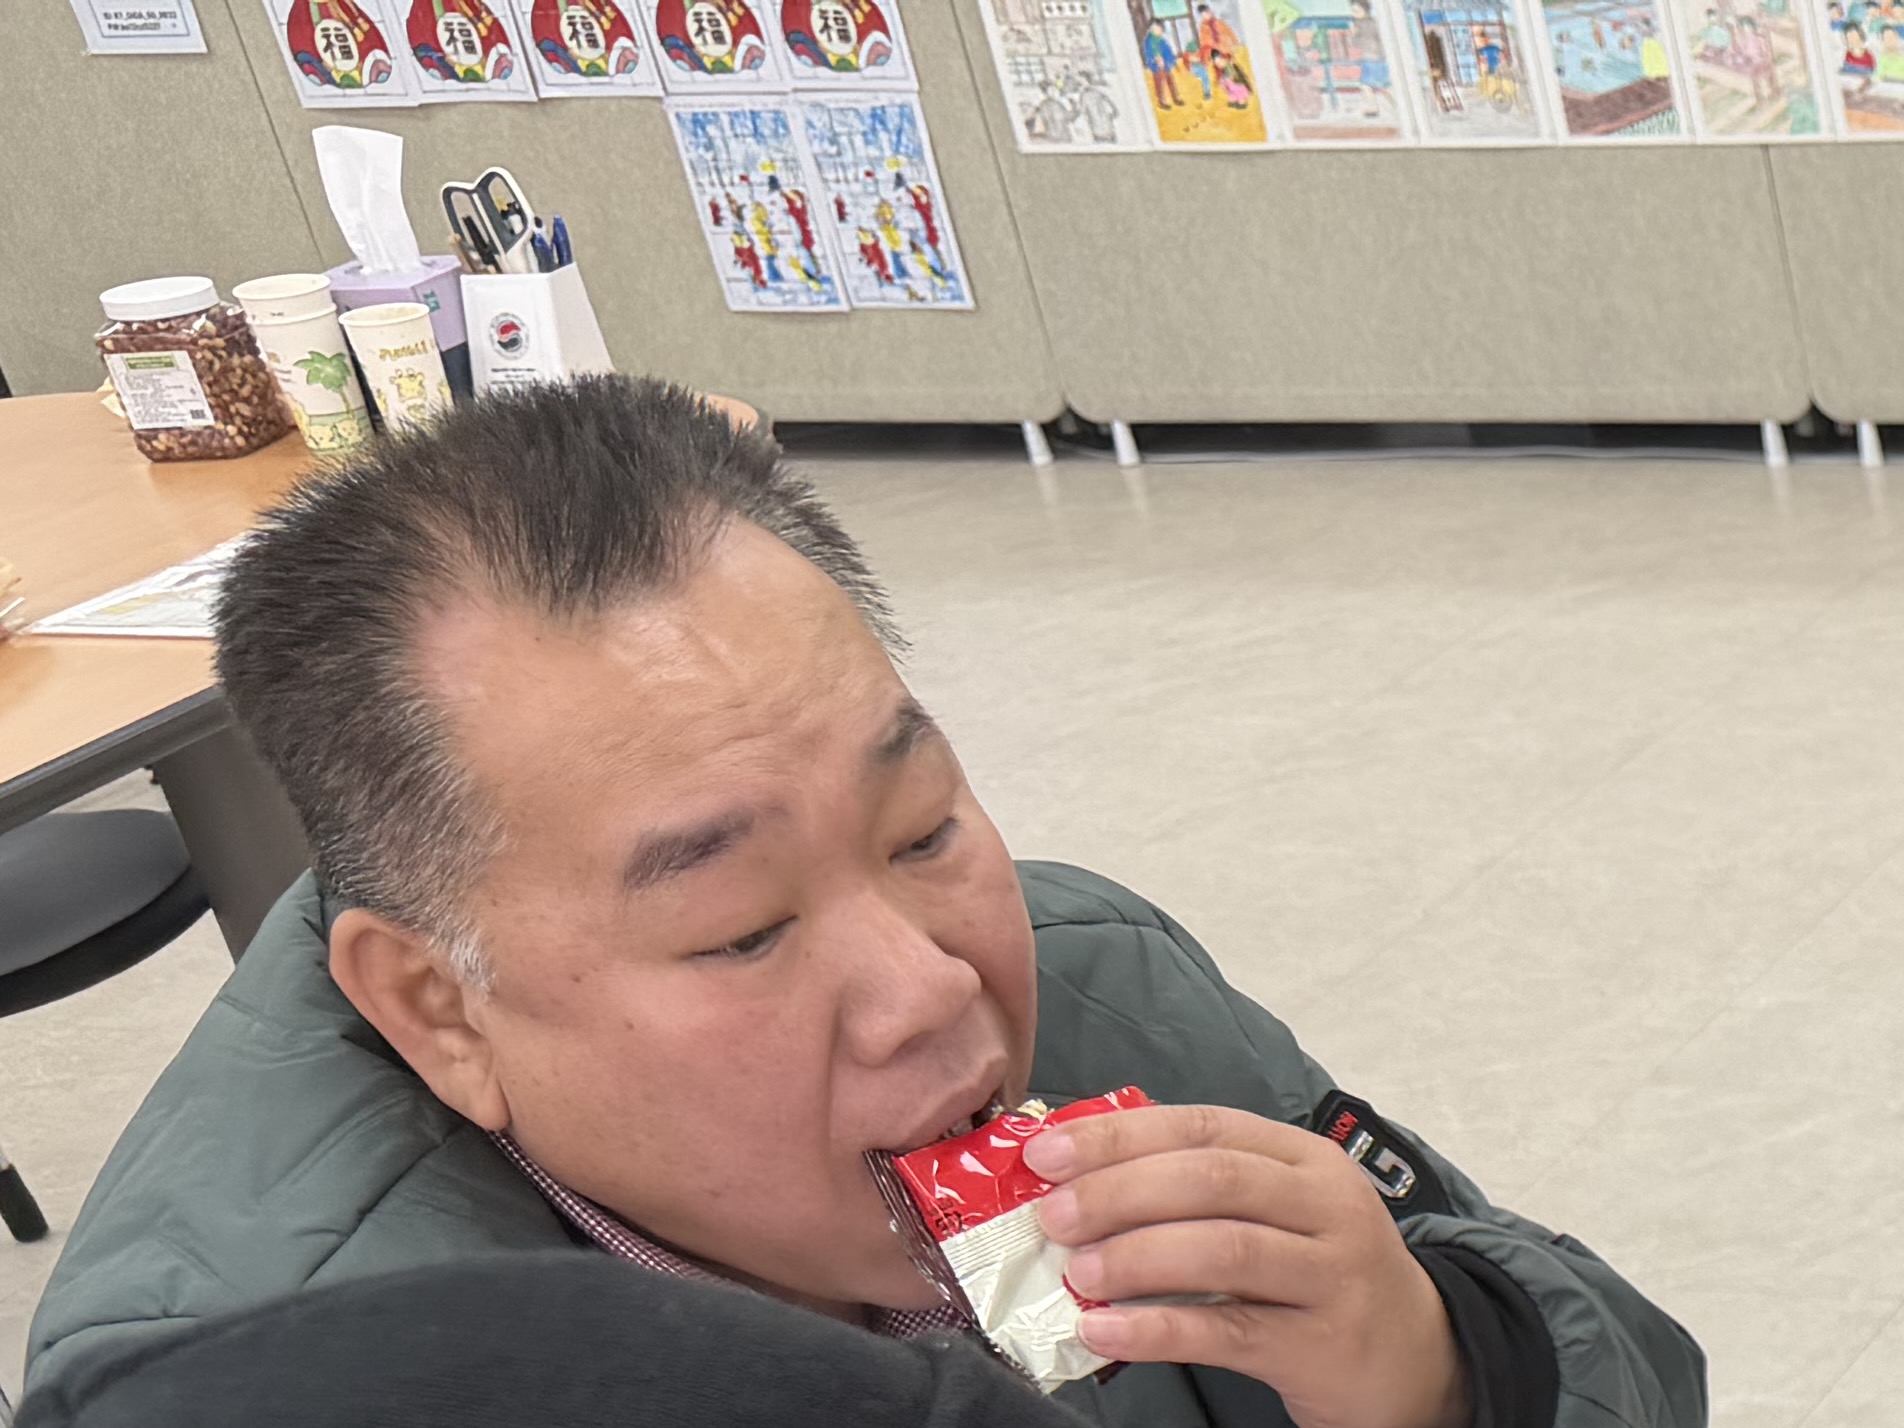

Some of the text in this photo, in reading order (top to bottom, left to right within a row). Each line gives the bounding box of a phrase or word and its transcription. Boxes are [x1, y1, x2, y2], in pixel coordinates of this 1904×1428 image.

[320, 26, 355, 61] 福
[444, 20, 478, 55] 福
[566, 14, 600, 49] 福
[693, 11, 727, 45] 福
[818, 9, 851, 43] 福
